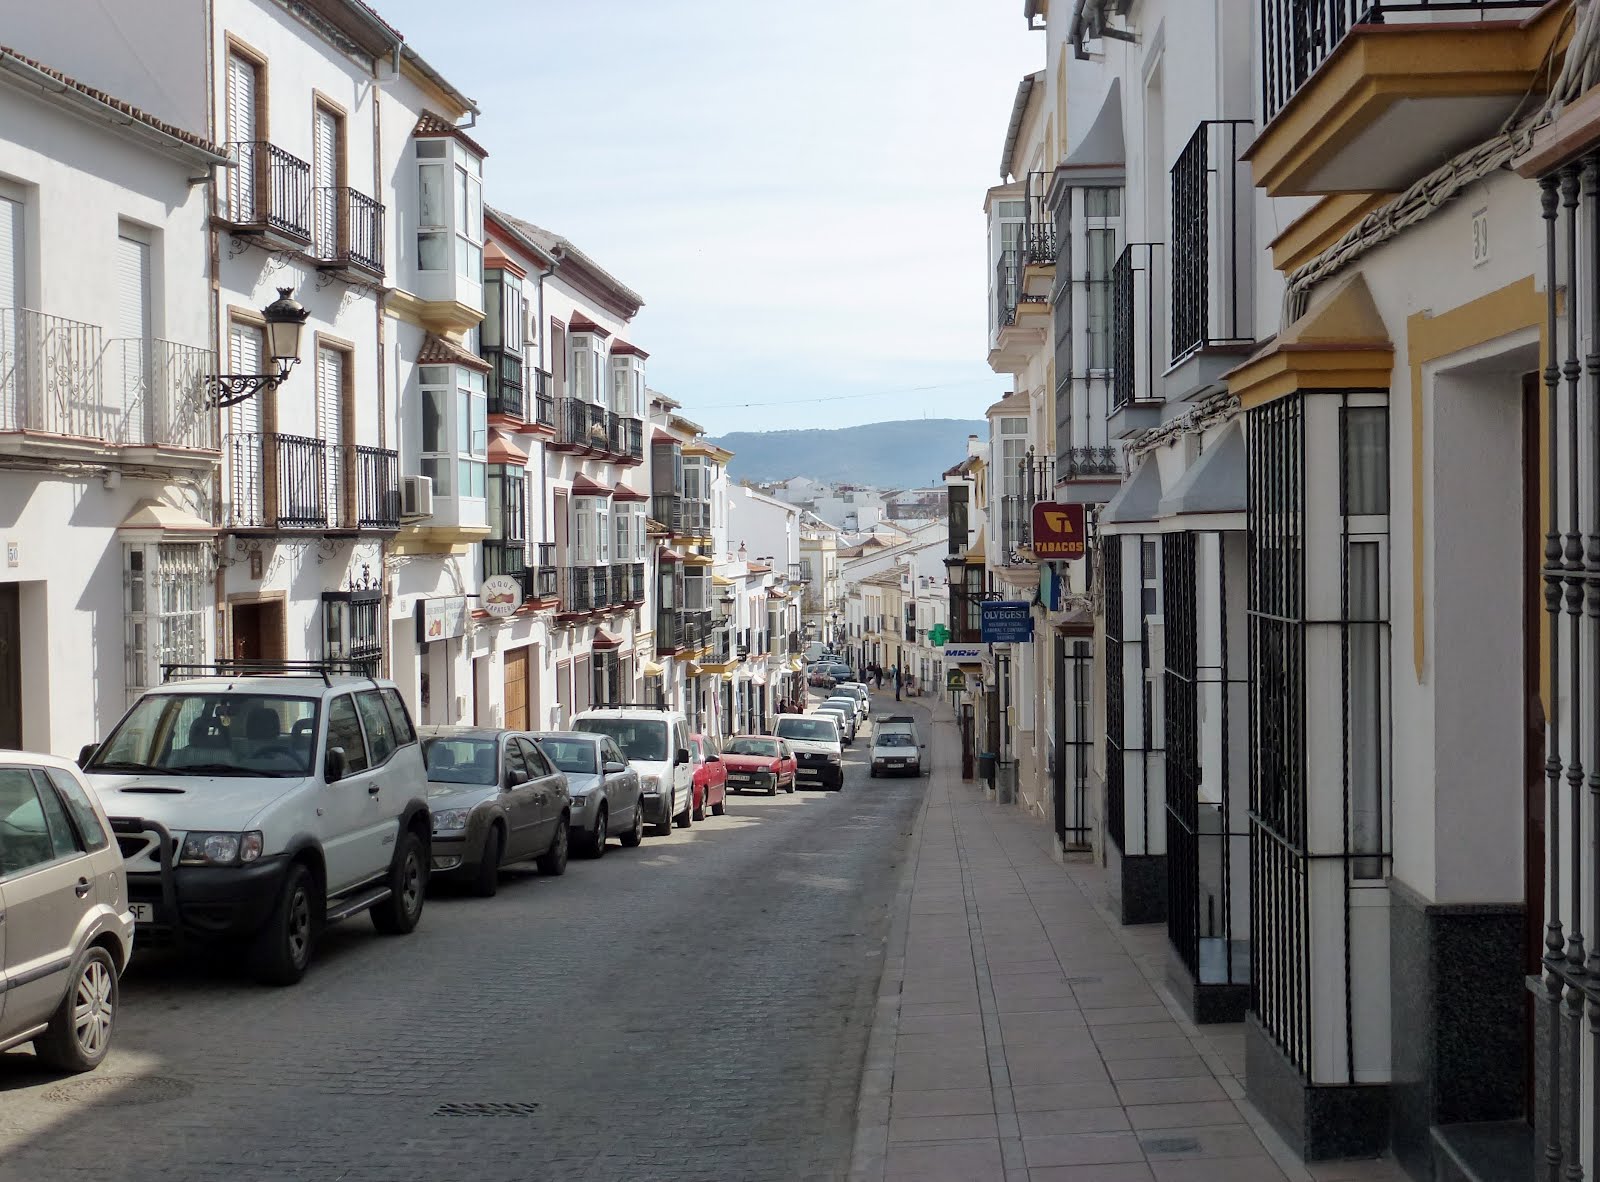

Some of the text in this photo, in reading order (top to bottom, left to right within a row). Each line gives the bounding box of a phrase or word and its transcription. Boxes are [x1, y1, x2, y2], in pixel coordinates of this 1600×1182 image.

[1473, 217, 1488, 261] 39
[1035, 541, 1084, 552] TABACOS
[9, 547, 19, 562] 50
[486, 580, 514, 591] LUQUE
[485, 603, 516, 614] ZAPATERO
[983, 610, 1027, 620] OLVEGEST
[944, 649, 981, 657] MRW
